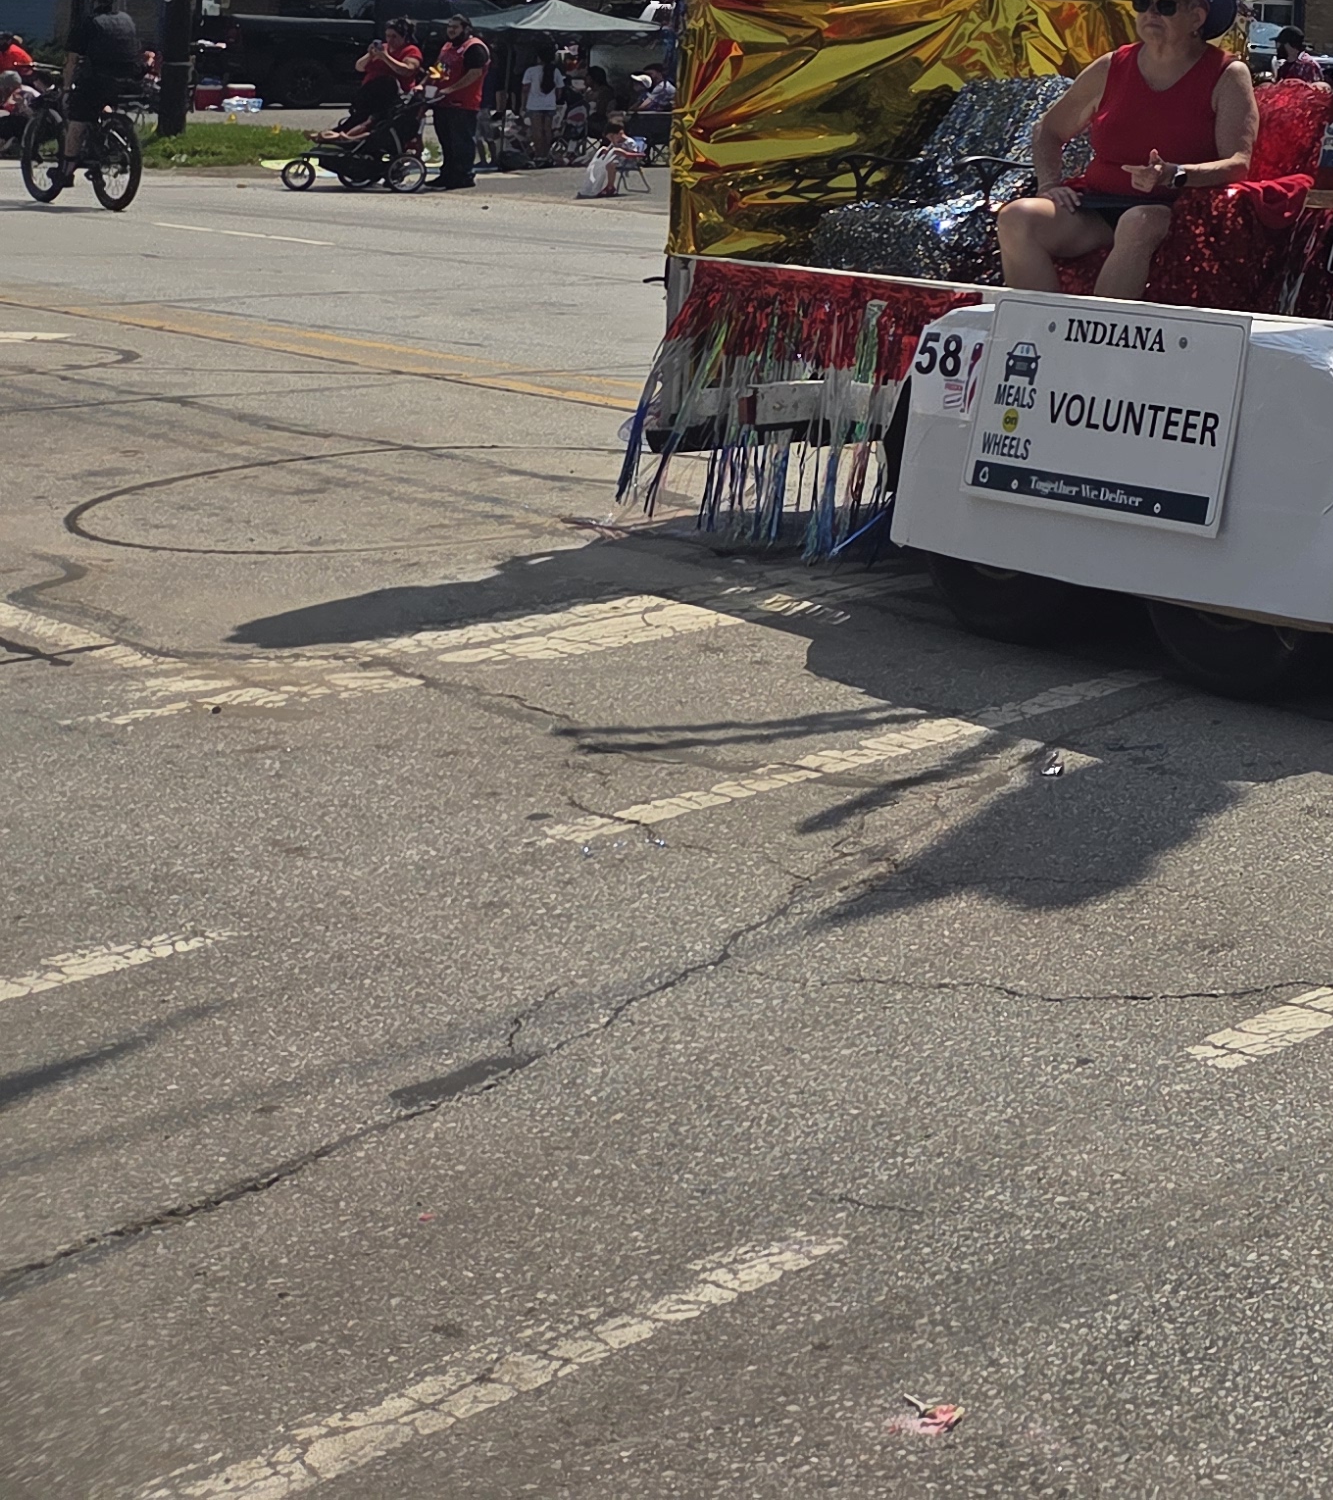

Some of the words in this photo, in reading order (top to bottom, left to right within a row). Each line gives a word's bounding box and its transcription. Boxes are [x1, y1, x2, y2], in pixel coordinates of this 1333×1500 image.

[1064, 318, 1166, 353] INDIANA
[915, 331, 963, 377] 58
[994, 383, 1037, 410] MEALS
[1003, 414, 1018, 426] on
[1050, 390, 1219, 447] VOLUNTEER
[981, 431, 1032, 460] WHEELS
[1029, 476, 1079, 500] Together
[1081, 484, 1099, 500] We
[1099, 487, 1143, 507] Deliver
